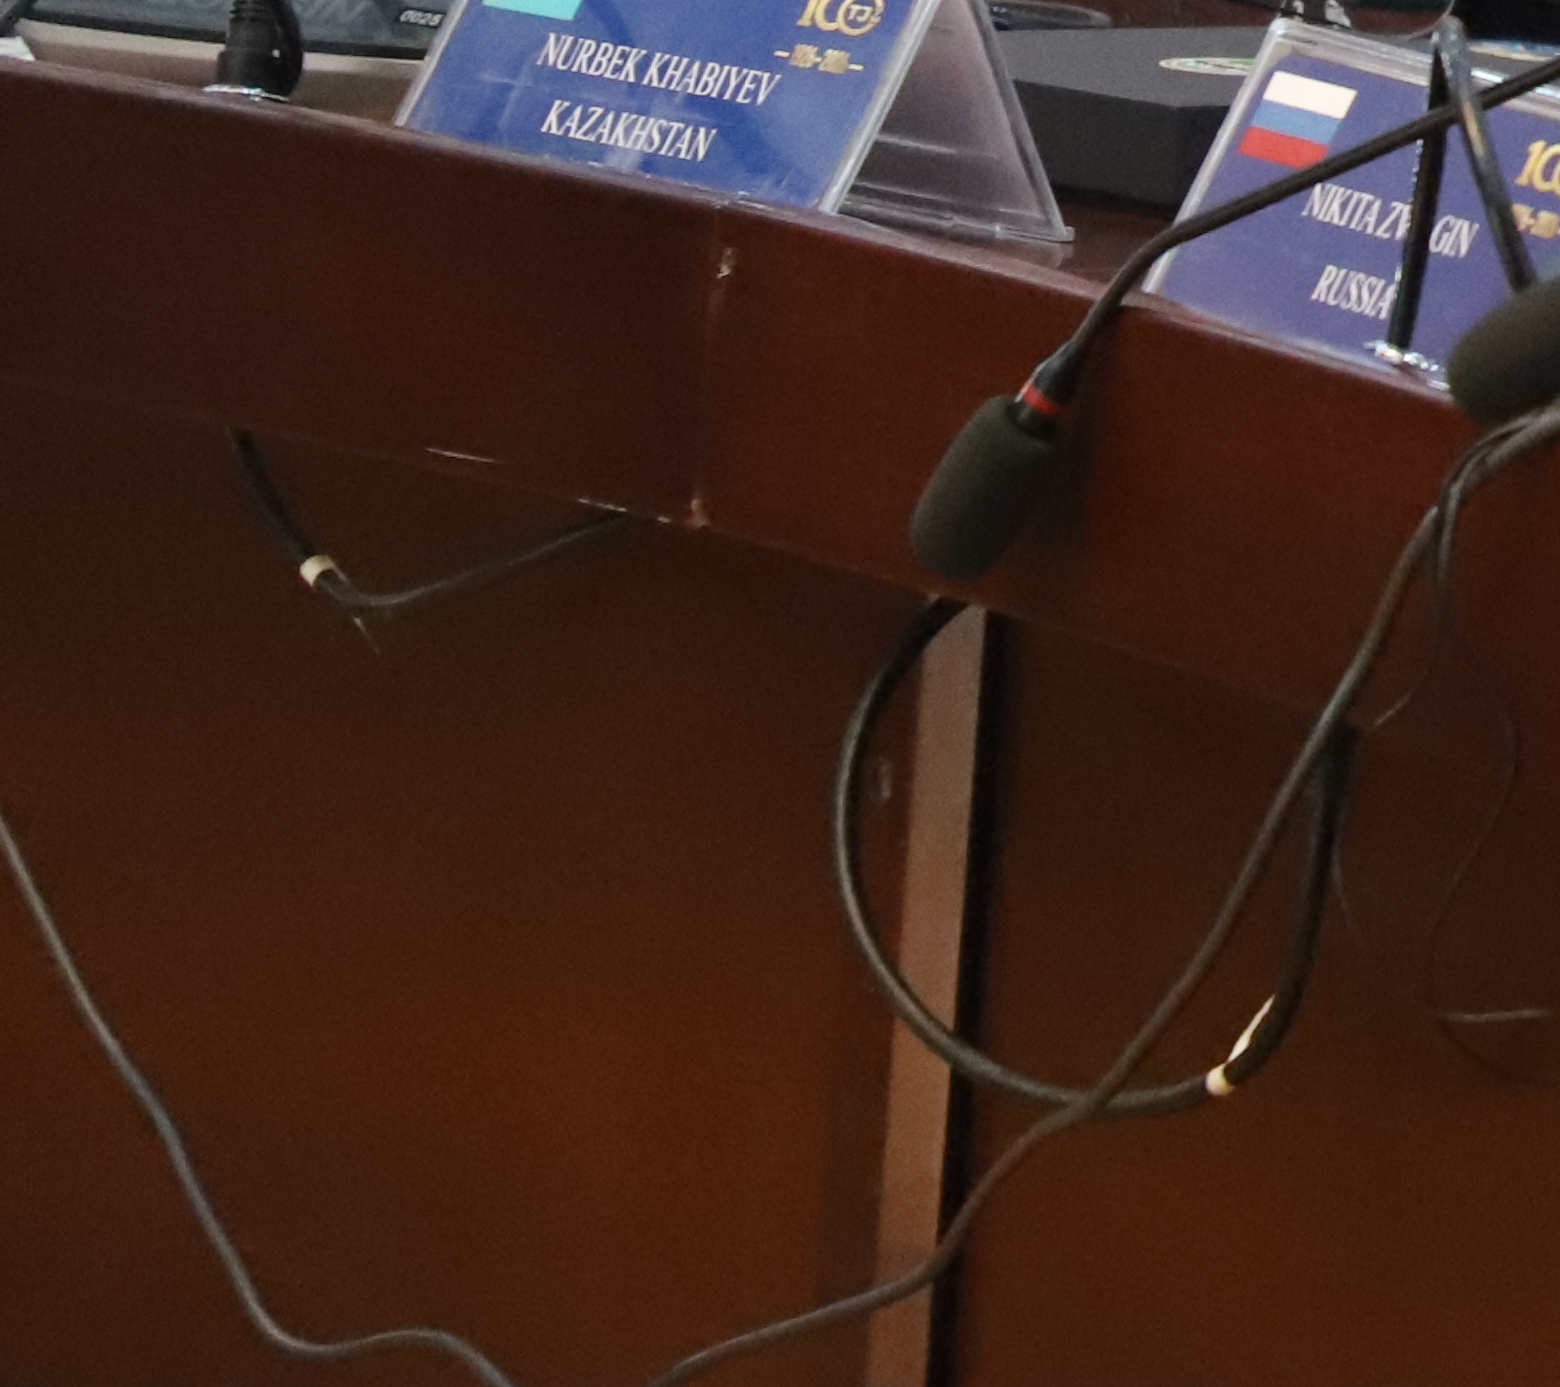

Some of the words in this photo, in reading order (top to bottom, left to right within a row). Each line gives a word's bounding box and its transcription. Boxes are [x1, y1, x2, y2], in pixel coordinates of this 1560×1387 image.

[536, 32, 648, 83] NURBEK
[642, 52, 782, 105] KHABIYEV
[540, 99, 717, 162] KAZAKHSTAN
[1301, 183, 1382, 237] NIKITA
[1375, 201, 1481, 259] ZVGIN
[1310, 263, 1398, 319] RUSSIA
